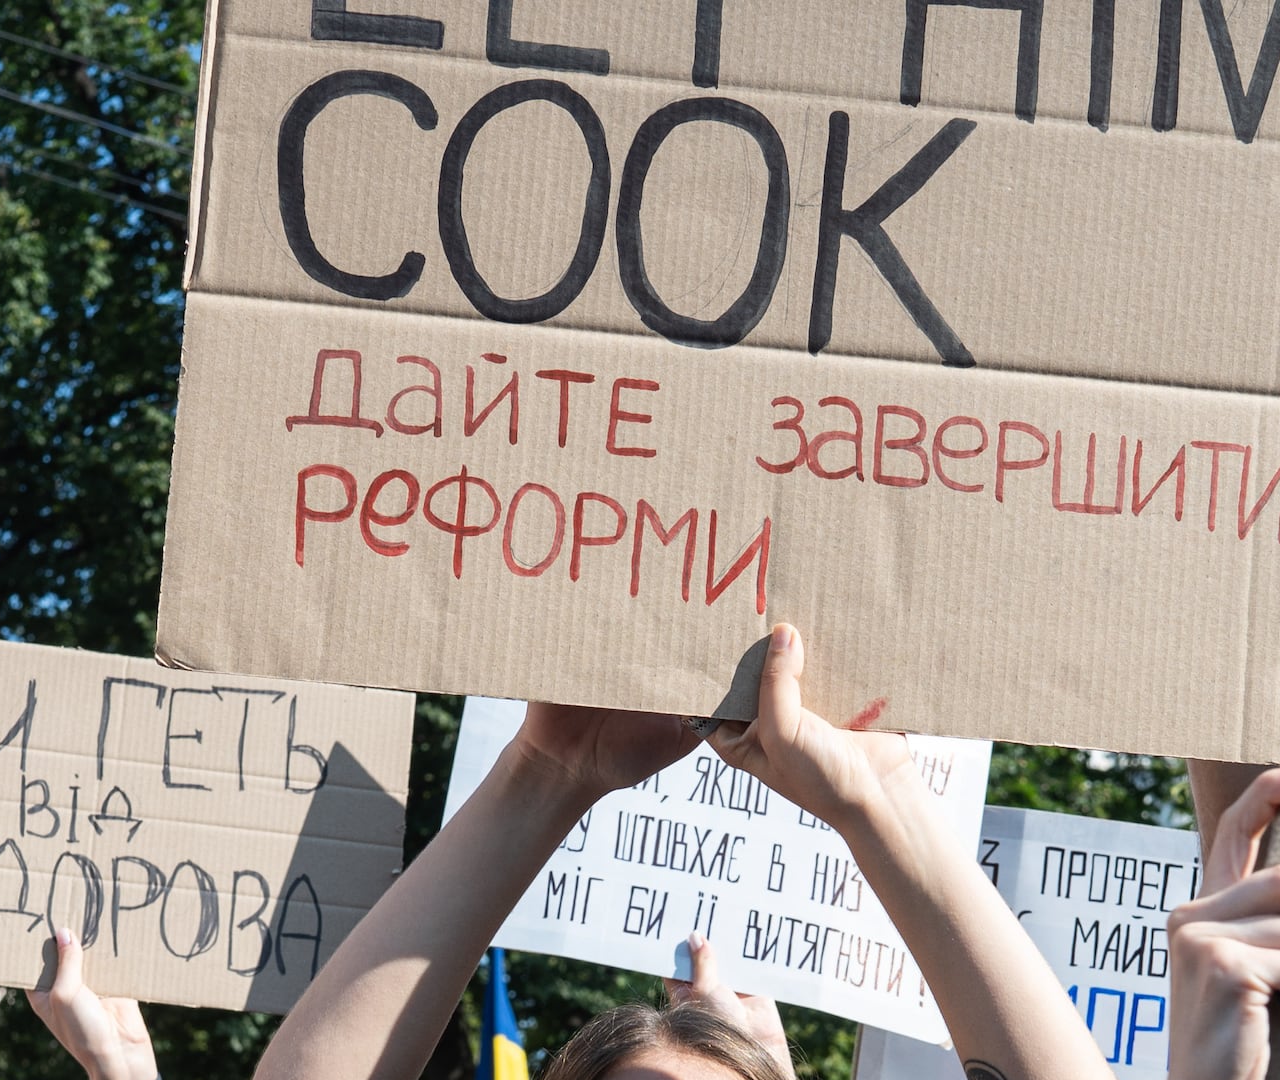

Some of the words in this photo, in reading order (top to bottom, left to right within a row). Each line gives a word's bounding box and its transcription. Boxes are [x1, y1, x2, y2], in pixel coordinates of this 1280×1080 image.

[277, 68, 977, 367] COOK
[98, 677, 328, 793] ГЕТЬ
[614, 811, 747, 884] ШТОВХАЄ
[767, 844, 786, 893] В
[623, 886, 669, 941] БИ
